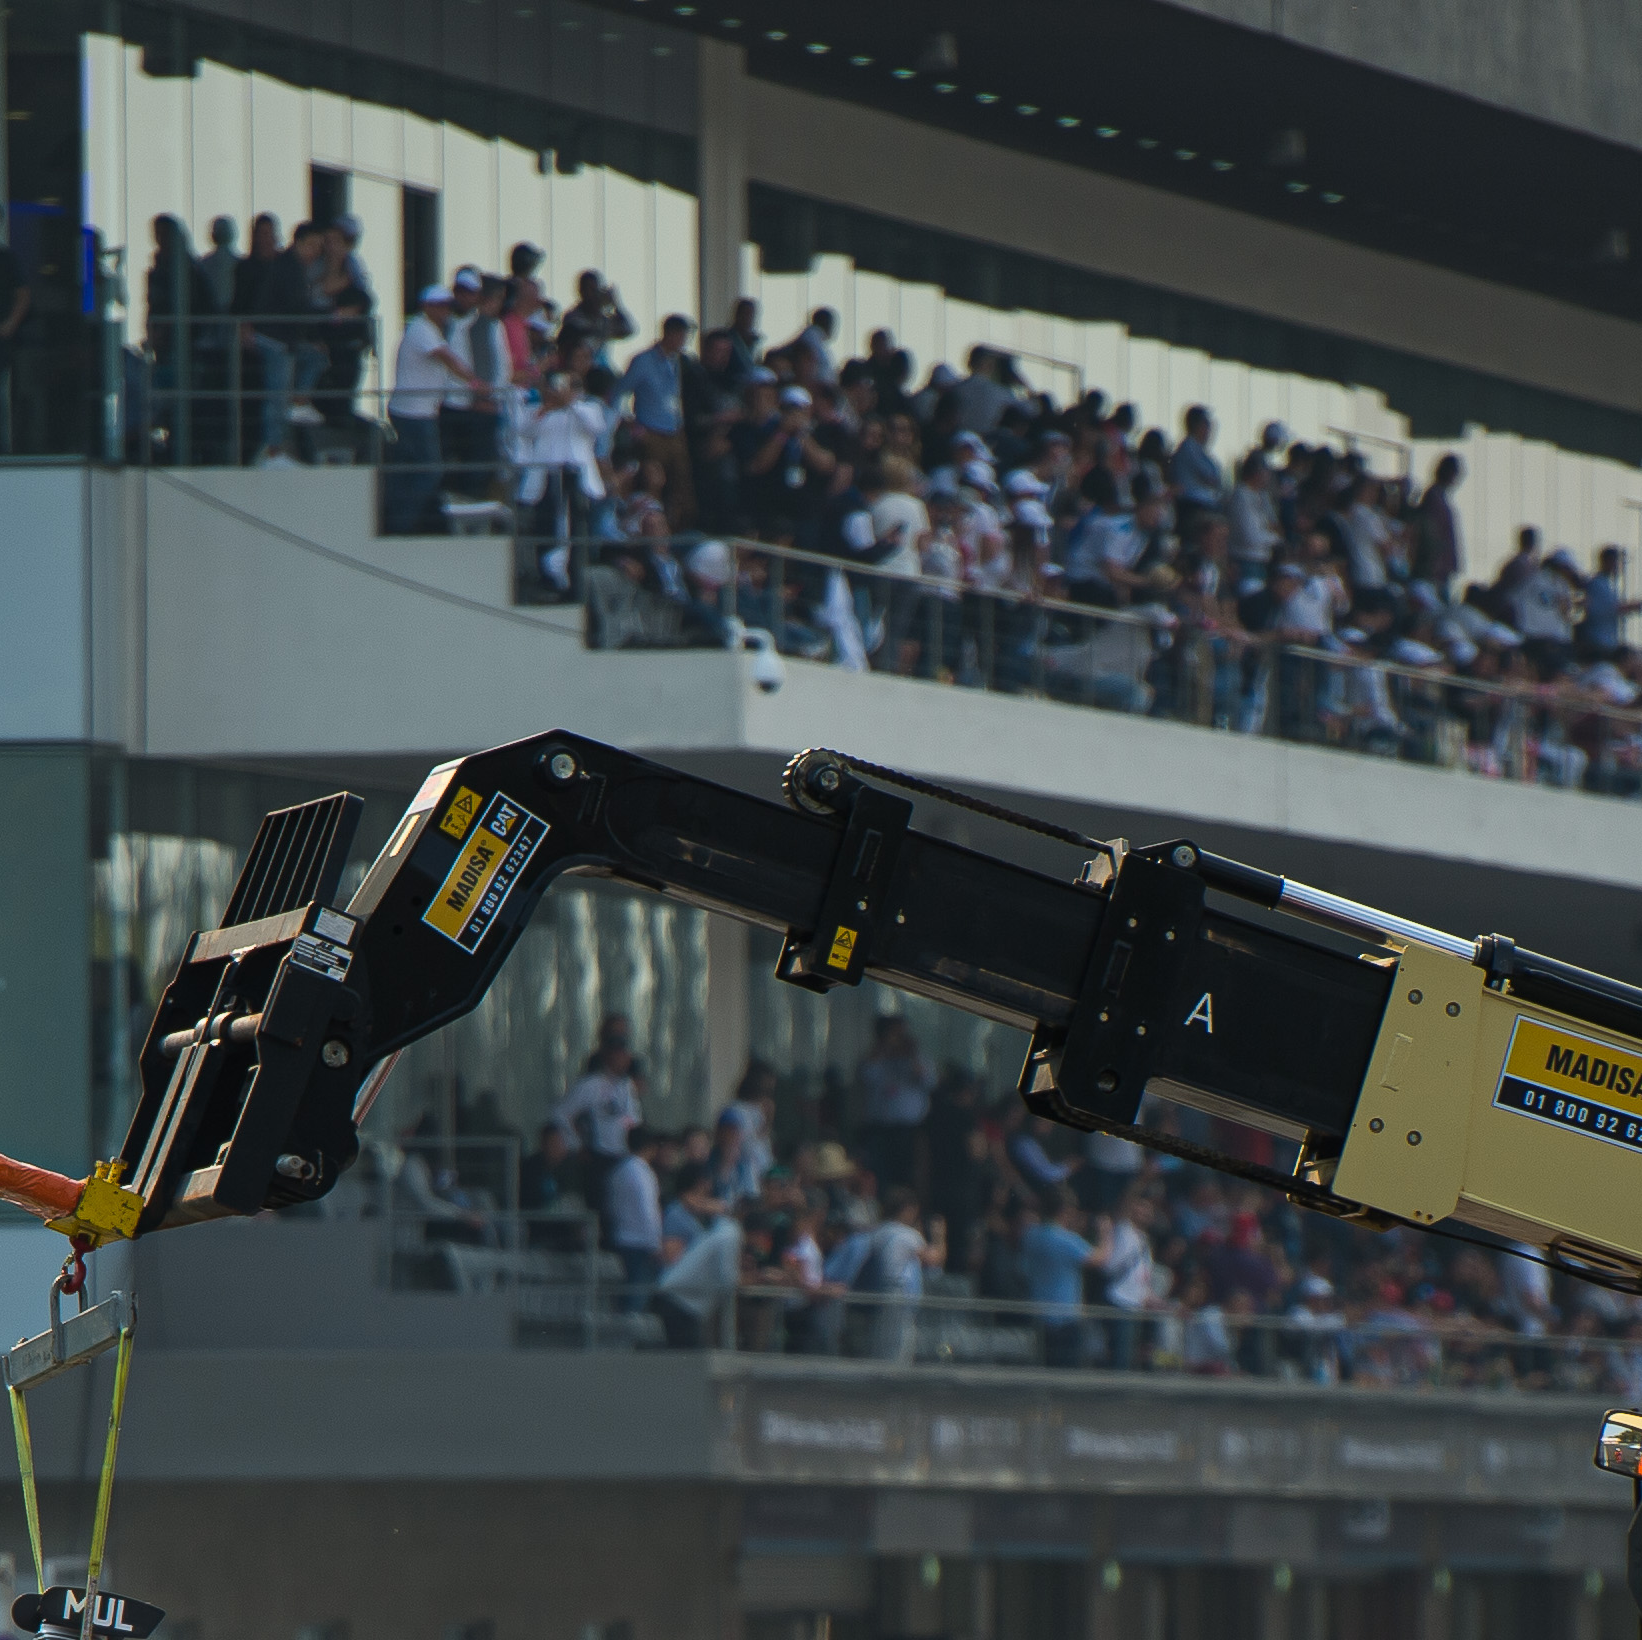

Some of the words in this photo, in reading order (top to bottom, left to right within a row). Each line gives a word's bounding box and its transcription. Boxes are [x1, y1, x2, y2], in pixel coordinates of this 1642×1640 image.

[446, 847, 495, 912] MADISA
[489, 803, 519, 837] CAT
[469, 917, 484, 933] 01
[481, 893, 498, 915] 800
[494, 875, 508, 891] 92
[505, 835, 532, 873] 62347
[1184, 992, 1213, 1034] A
[1524, 1090, 1546, 1109] 01
[1555, 1100, 1589, 1123] 800
[1596, 1113, 1619, 1133] 92
[63, 1589, 133, 1632] MUL
